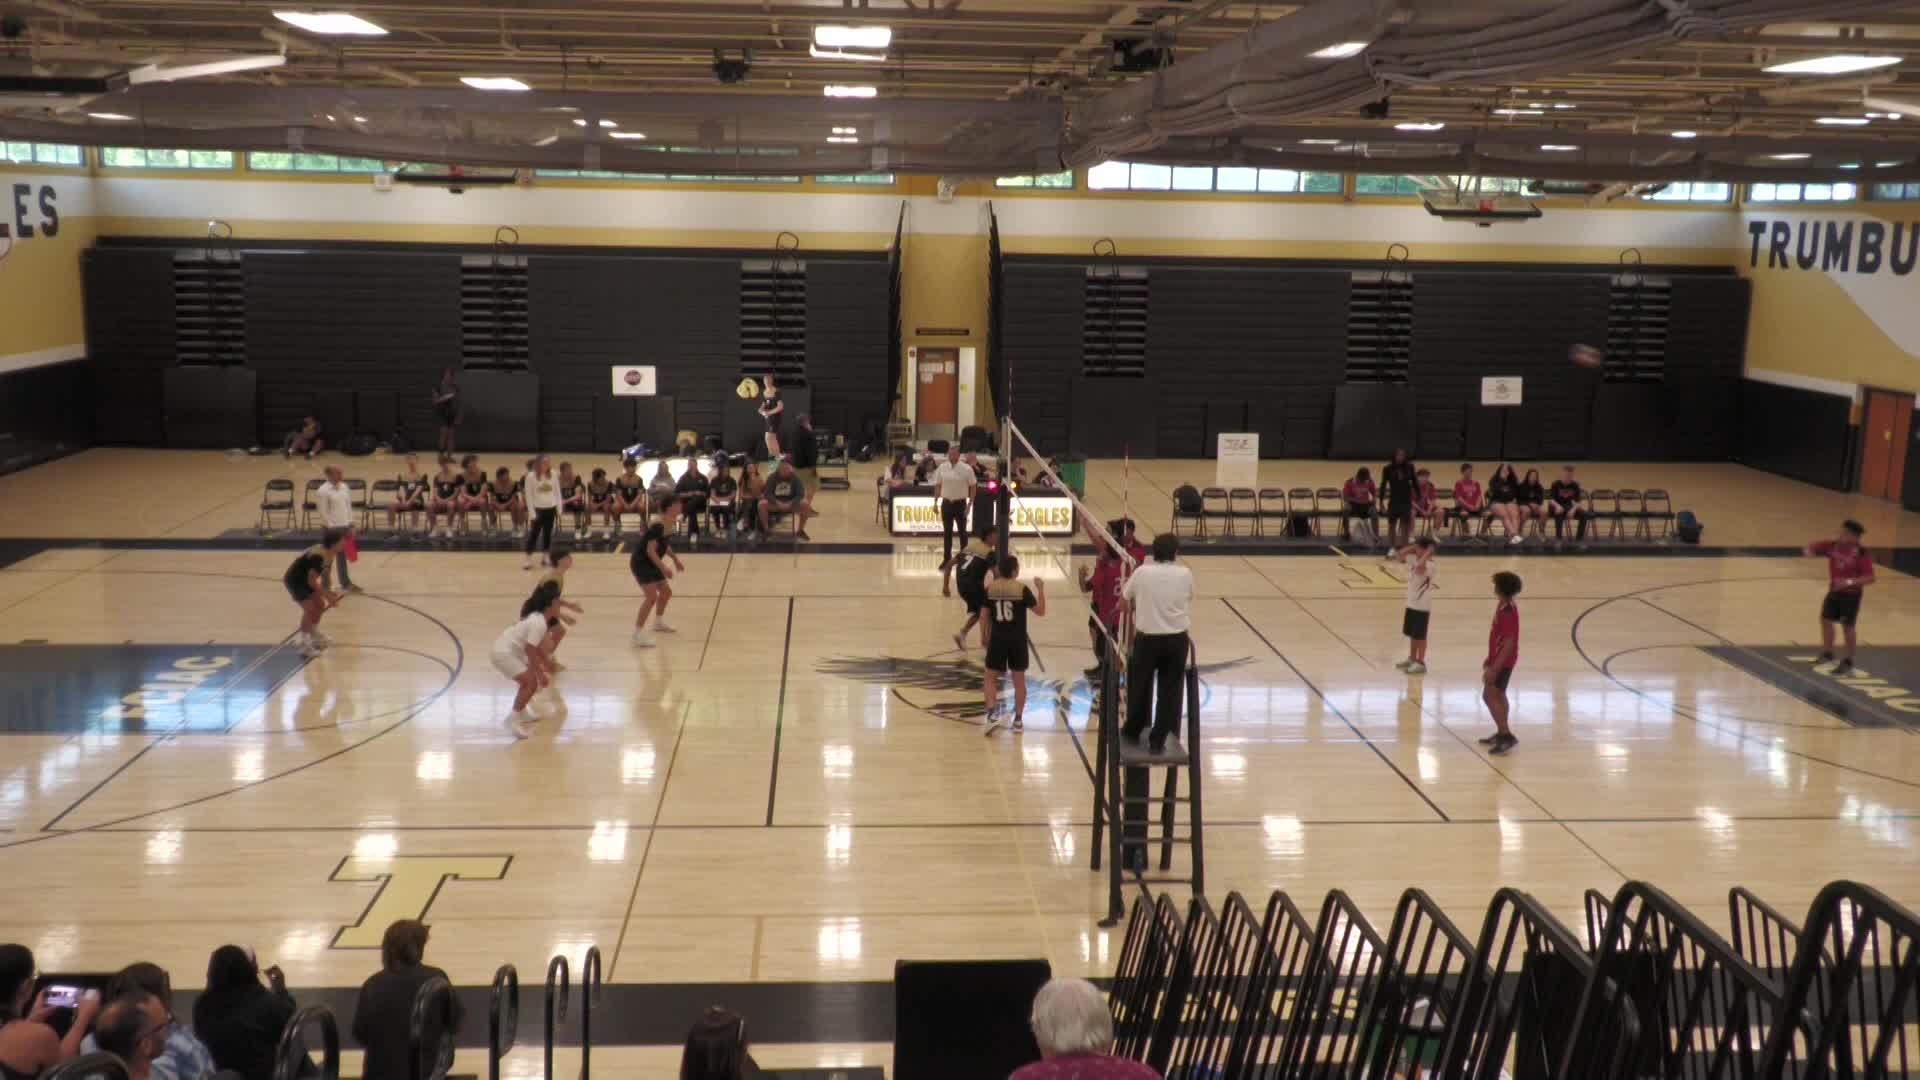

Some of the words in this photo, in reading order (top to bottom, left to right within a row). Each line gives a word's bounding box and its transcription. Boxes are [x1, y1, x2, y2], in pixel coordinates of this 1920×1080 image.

[1748, 220, 1920, 276] TRUMBU
[1016, 505, 1070, 526] EAGLES
[960, 555, 974, 569] 7
[995, 600, 1014, 621] 16
